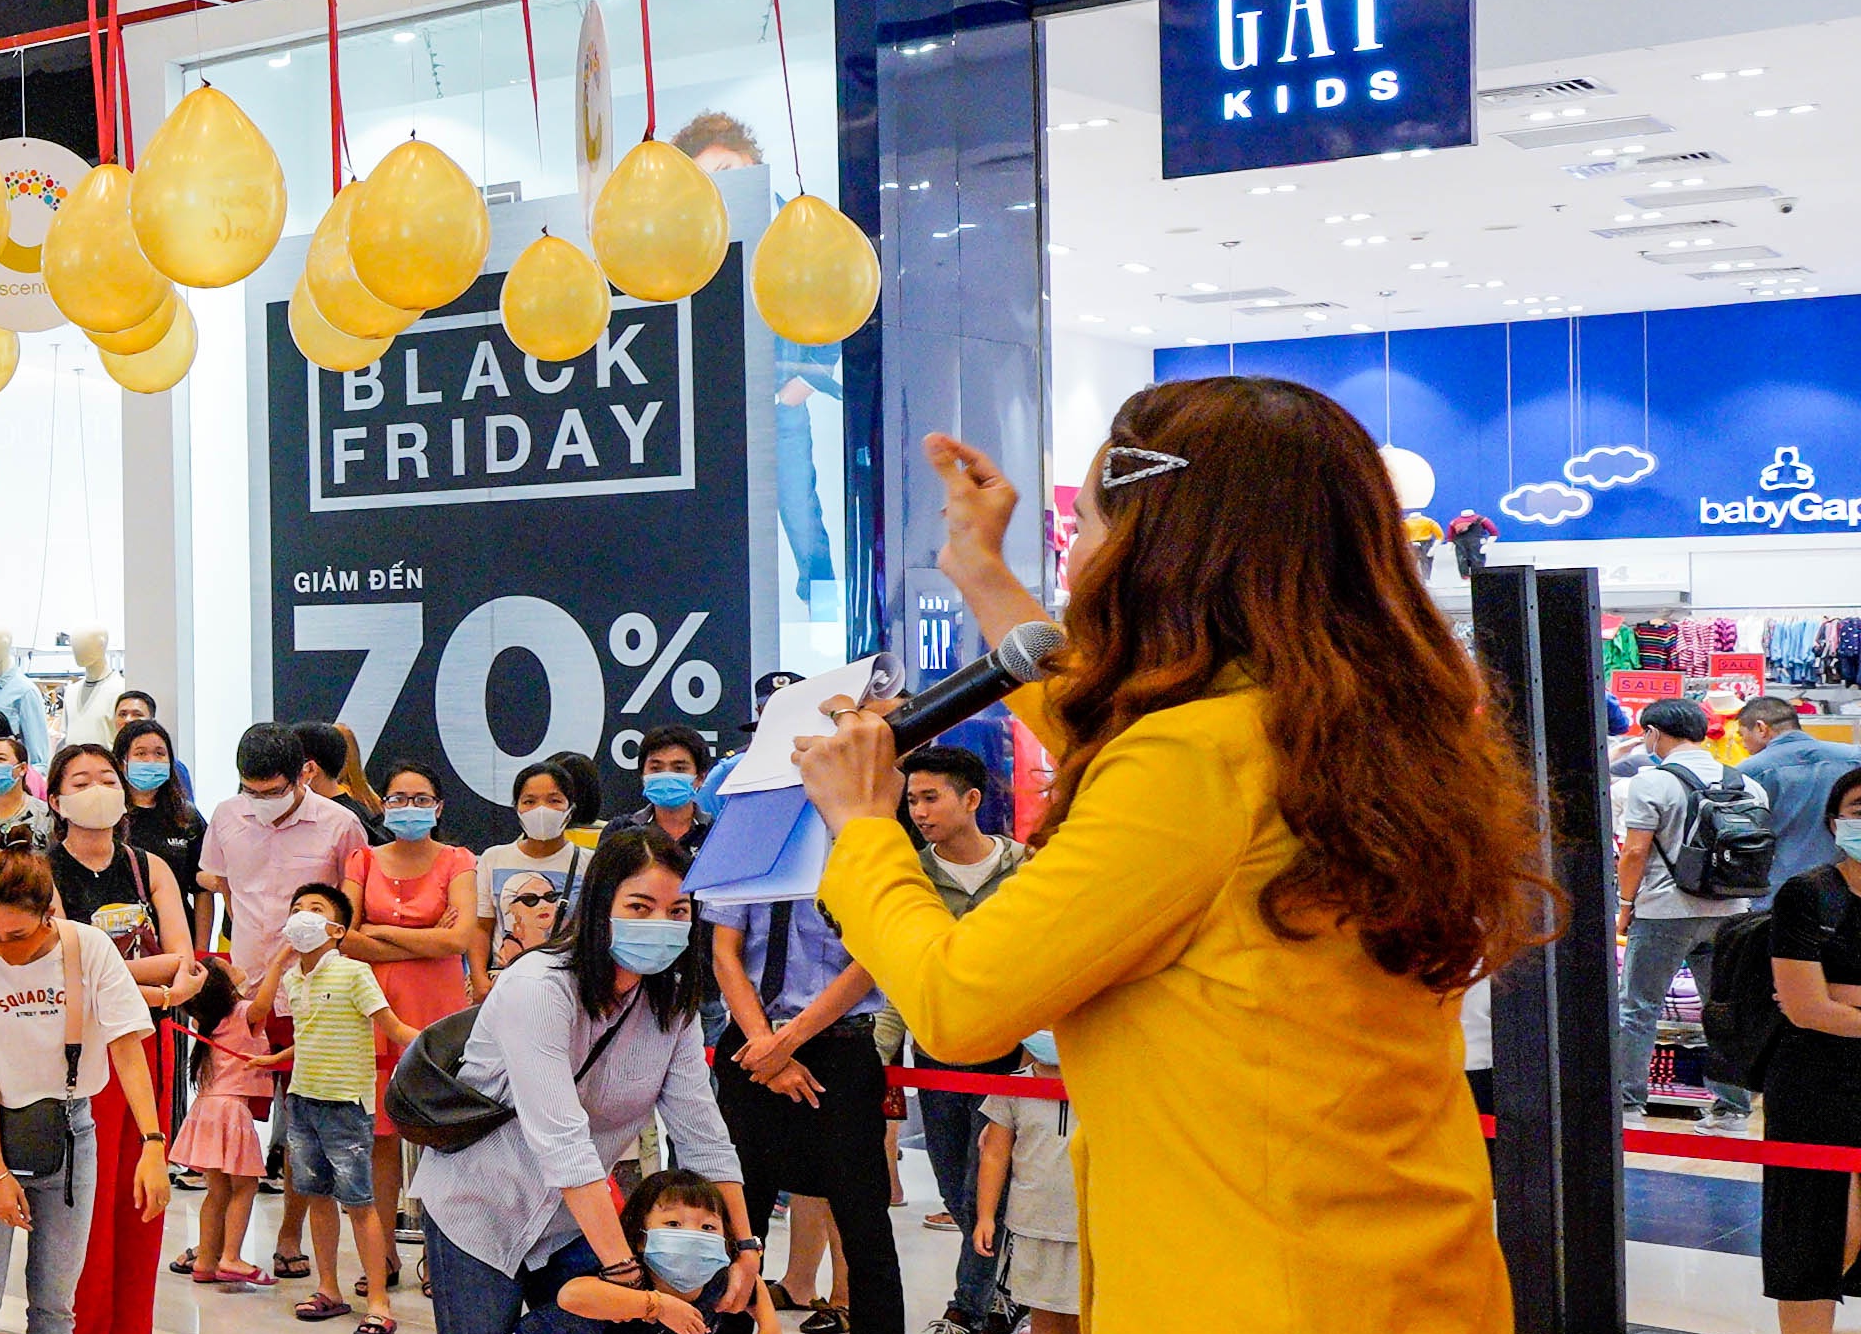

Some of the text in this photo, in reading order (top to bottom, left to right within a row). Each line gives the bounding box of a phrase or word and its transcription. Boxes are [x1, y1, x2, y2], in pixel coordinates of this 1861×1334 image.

[1223, 70, 1400, 120] KIDS
[342, 324, 648, 412] BLACK
[331, 400, 664, 485] FRIDAY
[293, 560, 424, 594] GIẢM ĐẾN
[919, 595, 950, 613] baby
[919, 618, 951, 670] GAP
[1719, 659, 1756, 670] SALE
[293, 594, 724, 810] 70%
[1621, 680, 1676, 692] SALE
[40, 1009, 59, 1017] WEAR
